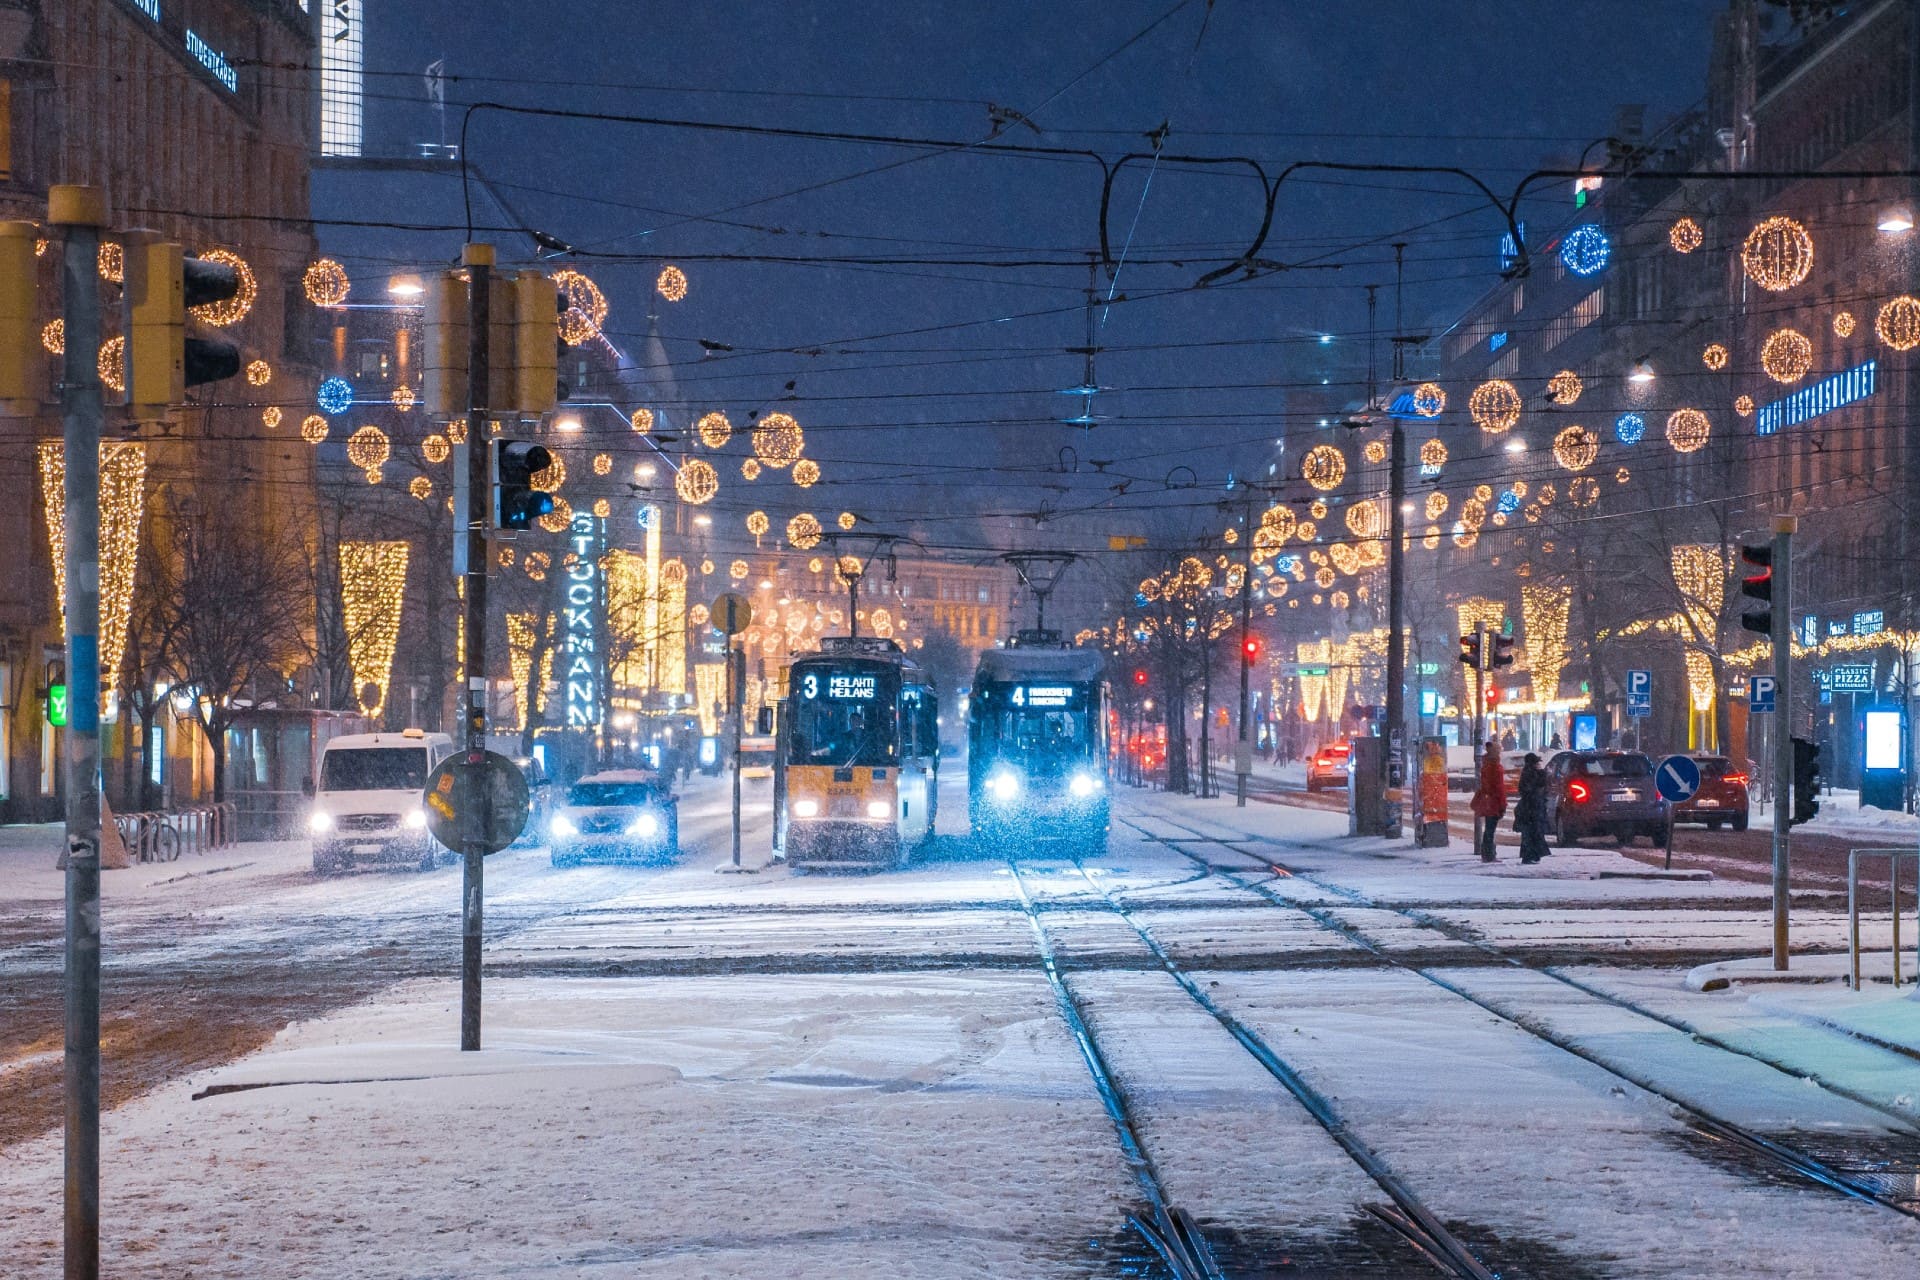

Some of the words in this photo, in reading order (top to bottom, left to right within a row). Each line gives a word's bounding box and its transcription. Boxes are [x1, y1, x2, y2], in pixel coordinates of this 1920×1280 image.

[567, 511, 594, 726] STOCKMANN
[804, 675, 818, 699] 3
[1632, 672, 1648, 692] P
[1834, 674, 1869, 683] PIZZA
[1012, 686, 1025, 706] 4
[1756, 678, 1774, 701] P
